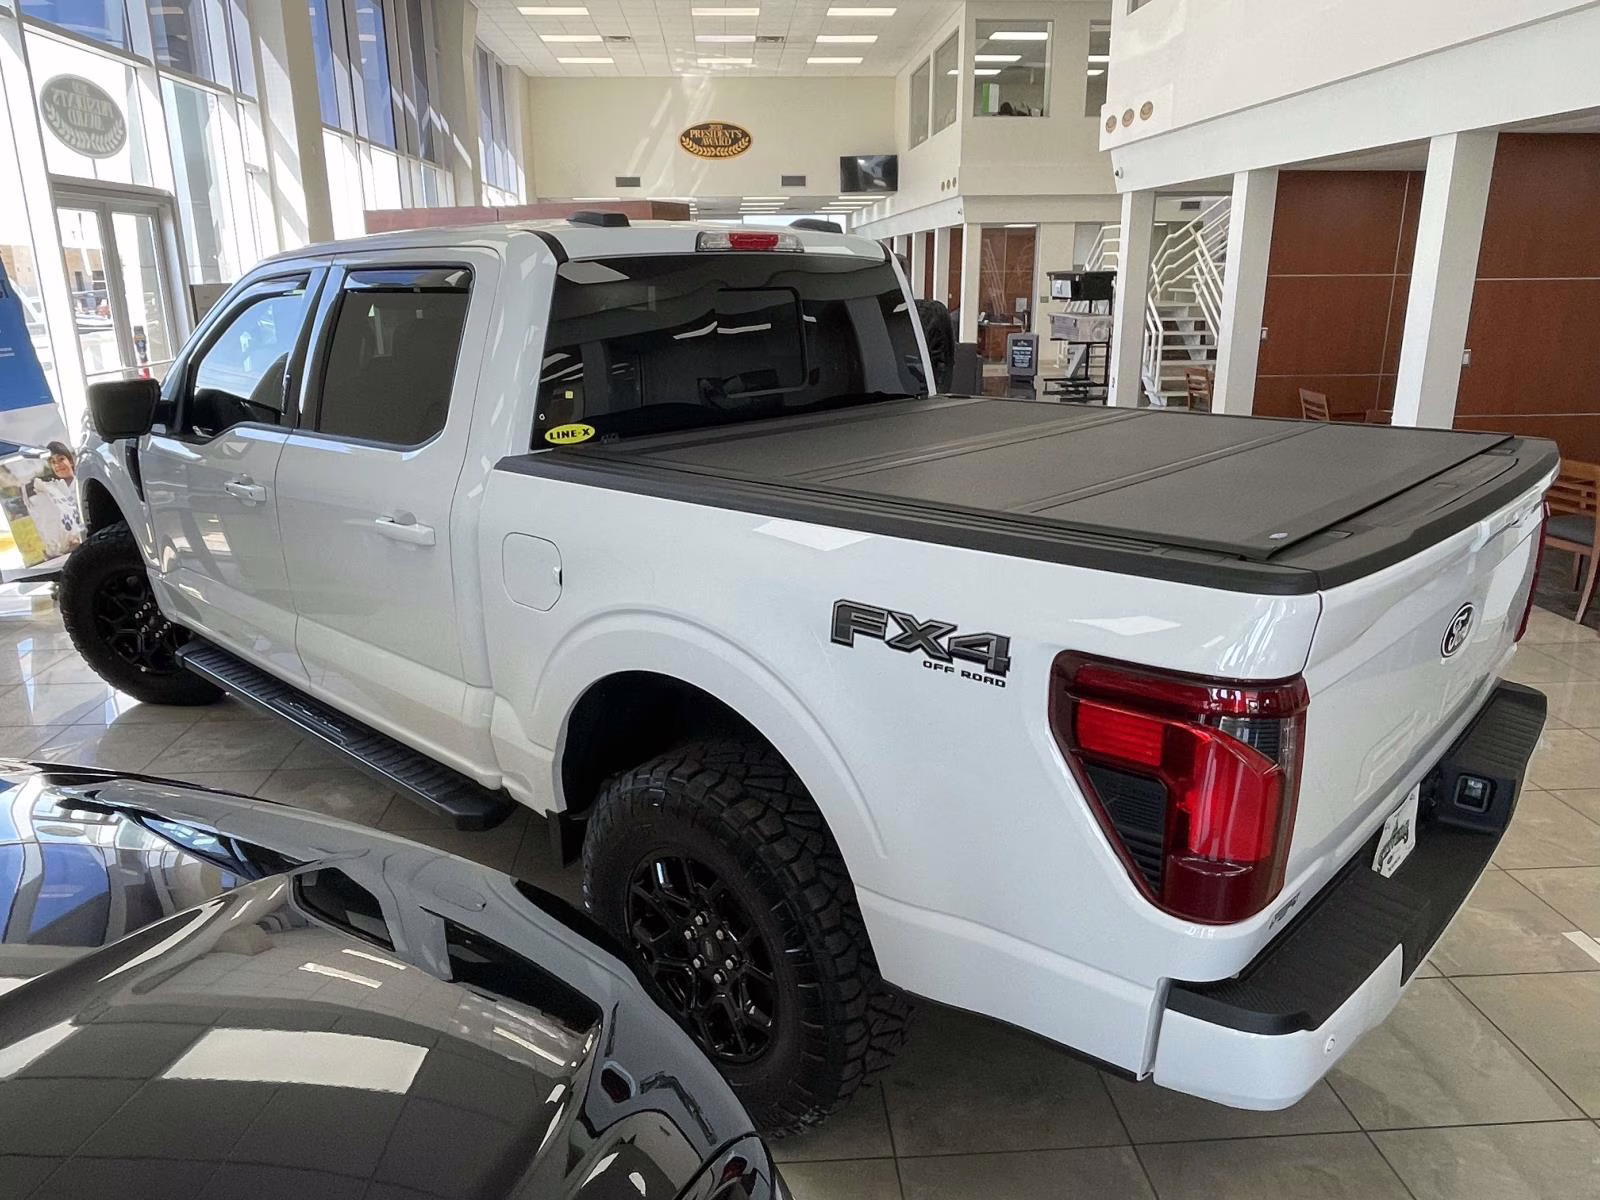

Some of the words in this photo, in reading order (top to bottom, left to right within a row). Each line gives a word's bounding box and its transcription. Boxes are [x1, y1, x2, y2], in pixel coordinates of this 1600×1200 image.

[701, 137, 732, 146] AWARD
[831, 598, 1011, 678] FX4
[922, 660, 955, 673] OFF
[961, 669, 1006, 688] ROAD
